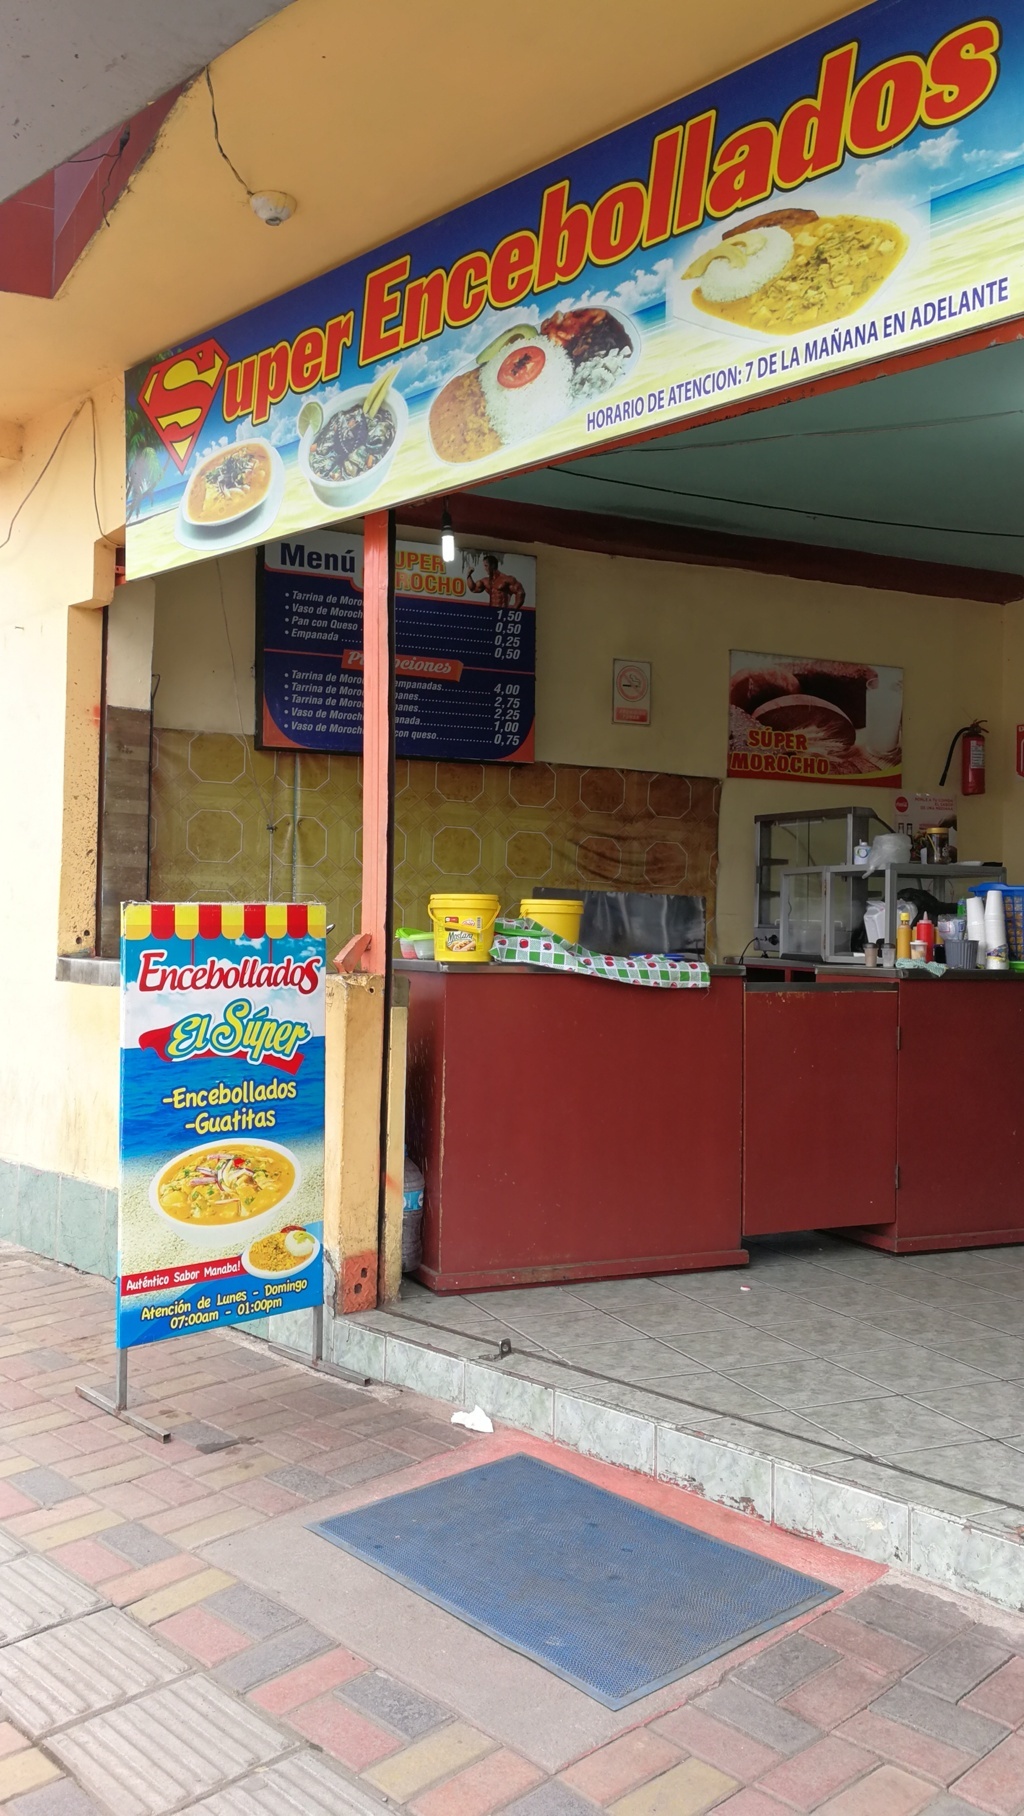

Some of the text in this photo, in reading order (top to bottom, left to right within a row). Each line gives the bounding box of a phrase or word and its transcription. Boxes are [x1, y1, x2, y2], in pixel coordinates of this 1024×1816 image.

[358, 16, 1002, 366] Encebollados
[587, 277, 1009, 431] HORARIO DE ATENCION: 7 DE LA MAÑANA EN ADELANTE
[280, 543, 355, 573] Menú
[395, 551, 446, 573] UPER
[395, 572, 466, 596] ROCHO
[292, 590, 523, 622] Tarrina de Moro 1,50
[292, 603, 522, 635] Vaso de Moroch 0,50
[291, 616, 521, 648] Pan con Queso 0,25
[291, 628, 521, 660] Empanada 0,50
[291, 670, 323, 681] Tarrina
[325, 673, 337, 682] de
[339, 674, 364, 685] Moro
[494, 683, 521, 696] 4,00
[291, 682, 323, 693] Tarrina
[325, 685, 337, 694] de
[339, 686, 364, 696] Moro
[494, 697, 521, 709] 2,75
[291, 694, 521, 721] Tarrina de Moro anes 2,25
[291, 707, 313, 717] Vaso
[315, 709, 327, 718] de
[329, 710, 364, 721] Moroch
[494, 721, 520, 733] 1,00
[291, 721, 313, 731] Vaso
[315, 723, 327, 732] de
[329, 724, 364, 735] Moroch
[411, 731, 437, 740] queso
[494, 733, 521, 746] 0,75
[748, 727, 808, 751] SÚPER
[730, 752, 830, 775] MOROCHO
[139, 952, 321, 994] Encebollados
[166, 998, 309, 1061] El Súper
[126, 1260, 241, 1291] Auténtico Sabor Manaba!
[141, 1299, 191, 1321] Atención
[197, 1295, 211, 1308] de
[216, 1290, 247, 1303] Lunes
[264, 1278, 308, 1298] Domingo
[170, 1310, 219, 1330] 07:00am
[237, 1296, 283, 1317] 01:00pm
